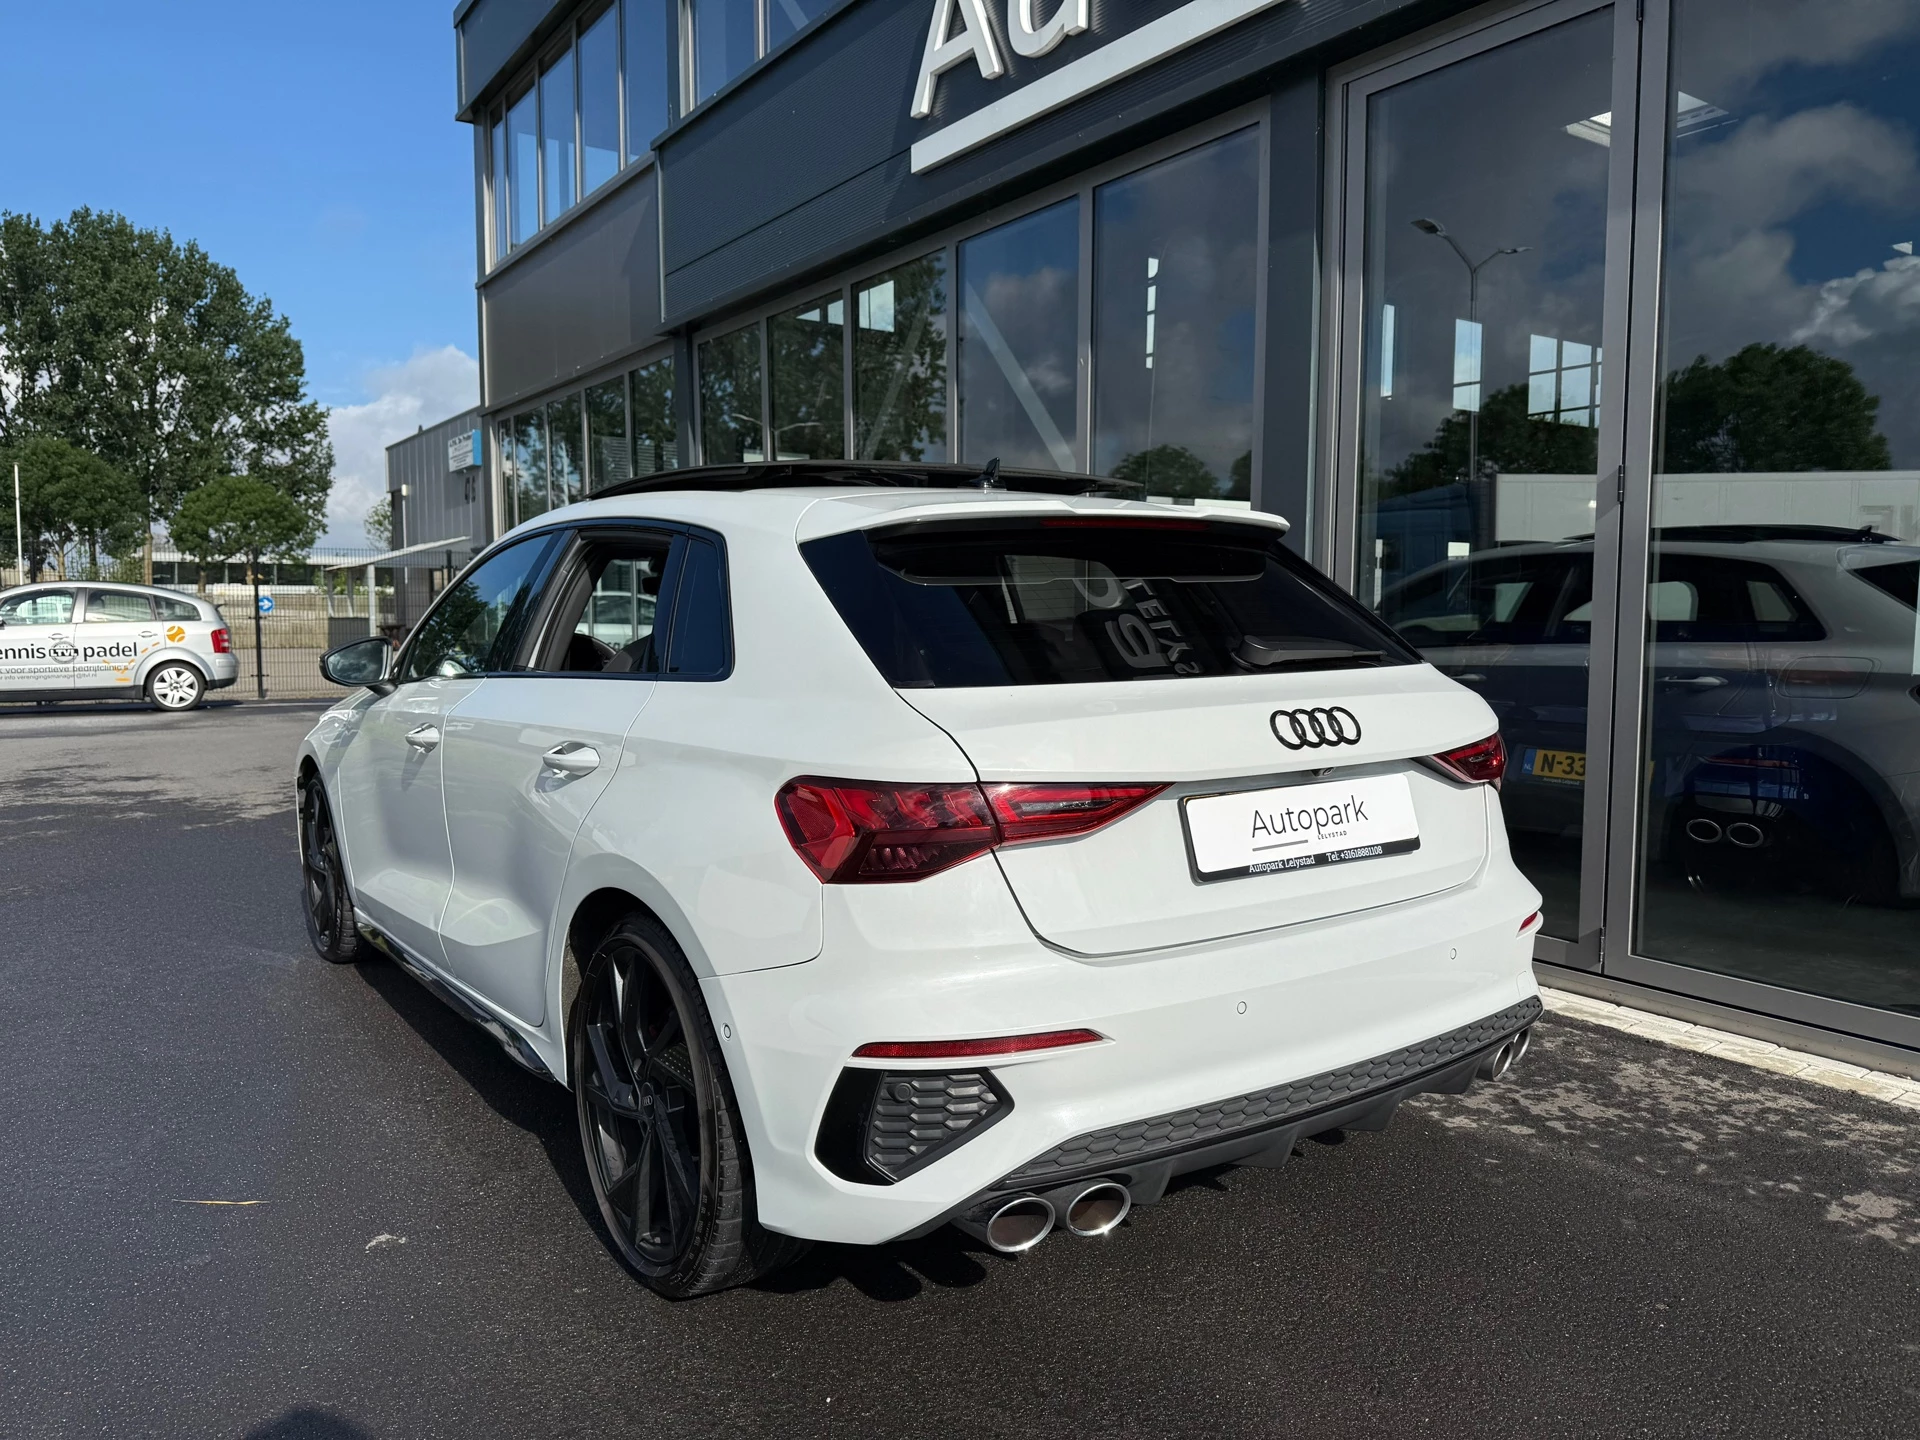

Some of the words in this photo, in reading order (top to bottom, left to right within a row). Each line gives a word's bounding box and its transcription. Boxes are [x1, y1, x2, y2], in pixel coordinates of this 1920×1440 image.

[49, 648, 79, 657] LTVL
[83, 642, 137, 662] padel
[28, 666, 69, 674] sportieve
[1251, 794, 1369, 838] Autopark
[1317, 830, 1347, 840] LELYSTAD
[1249, 860, 1284, 873] Autopark
[1284, 854, 1316, 869] Lelystad
